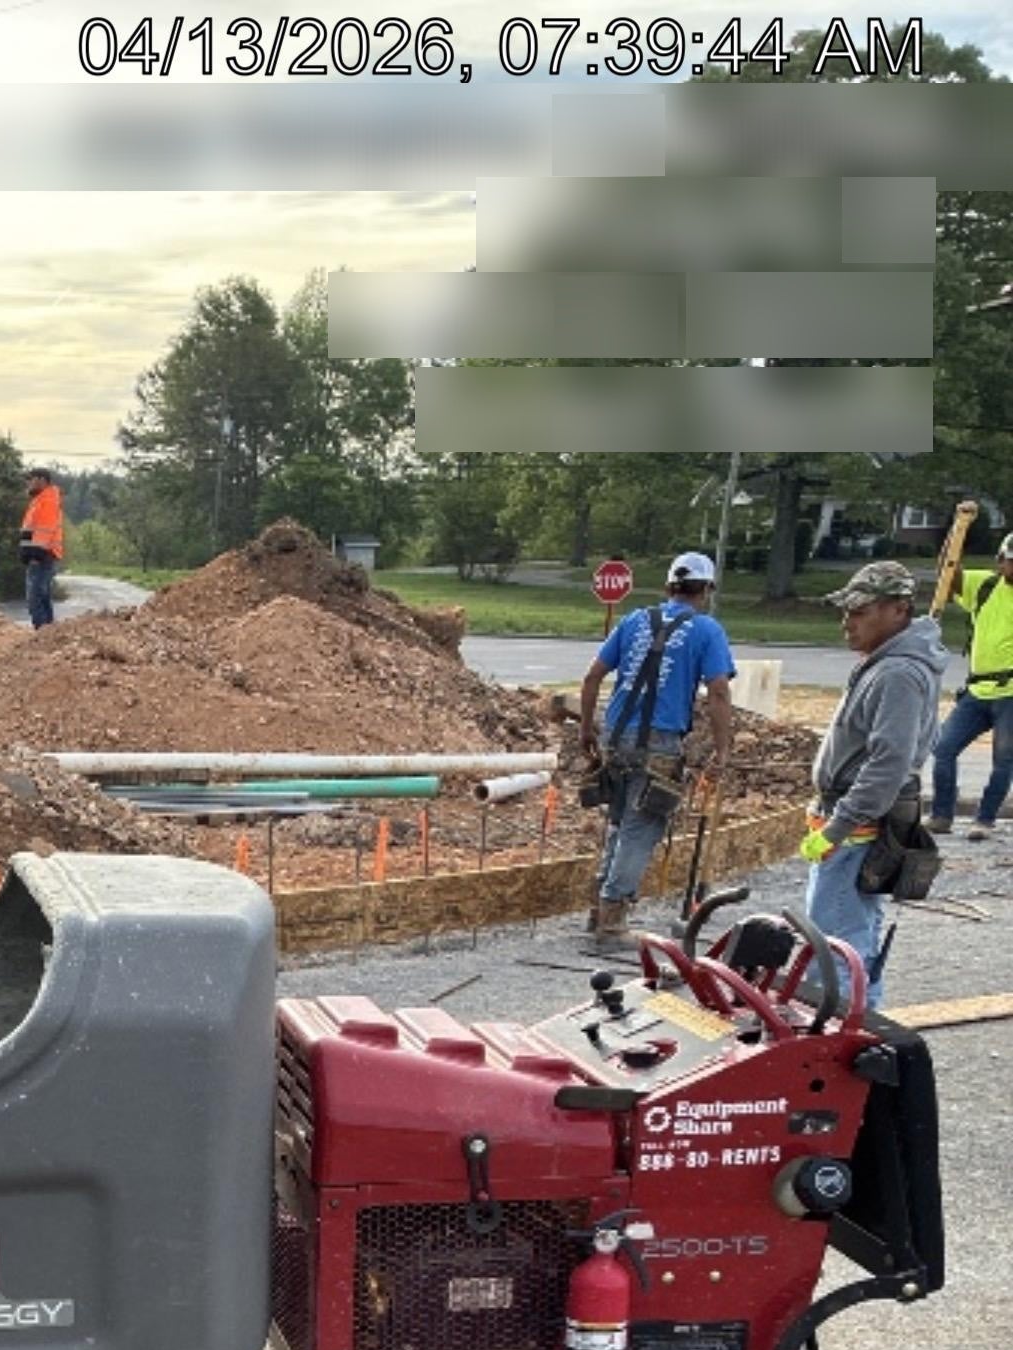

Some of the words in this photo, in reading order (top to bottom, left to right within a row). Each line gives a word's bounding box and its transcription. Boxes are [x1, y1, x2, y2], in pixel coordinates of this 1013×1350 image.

[595, 574, 630, 589] STOP
[675, 1098, 788, 1119] Equipment
[673, 1119, 733, 1135] Share
